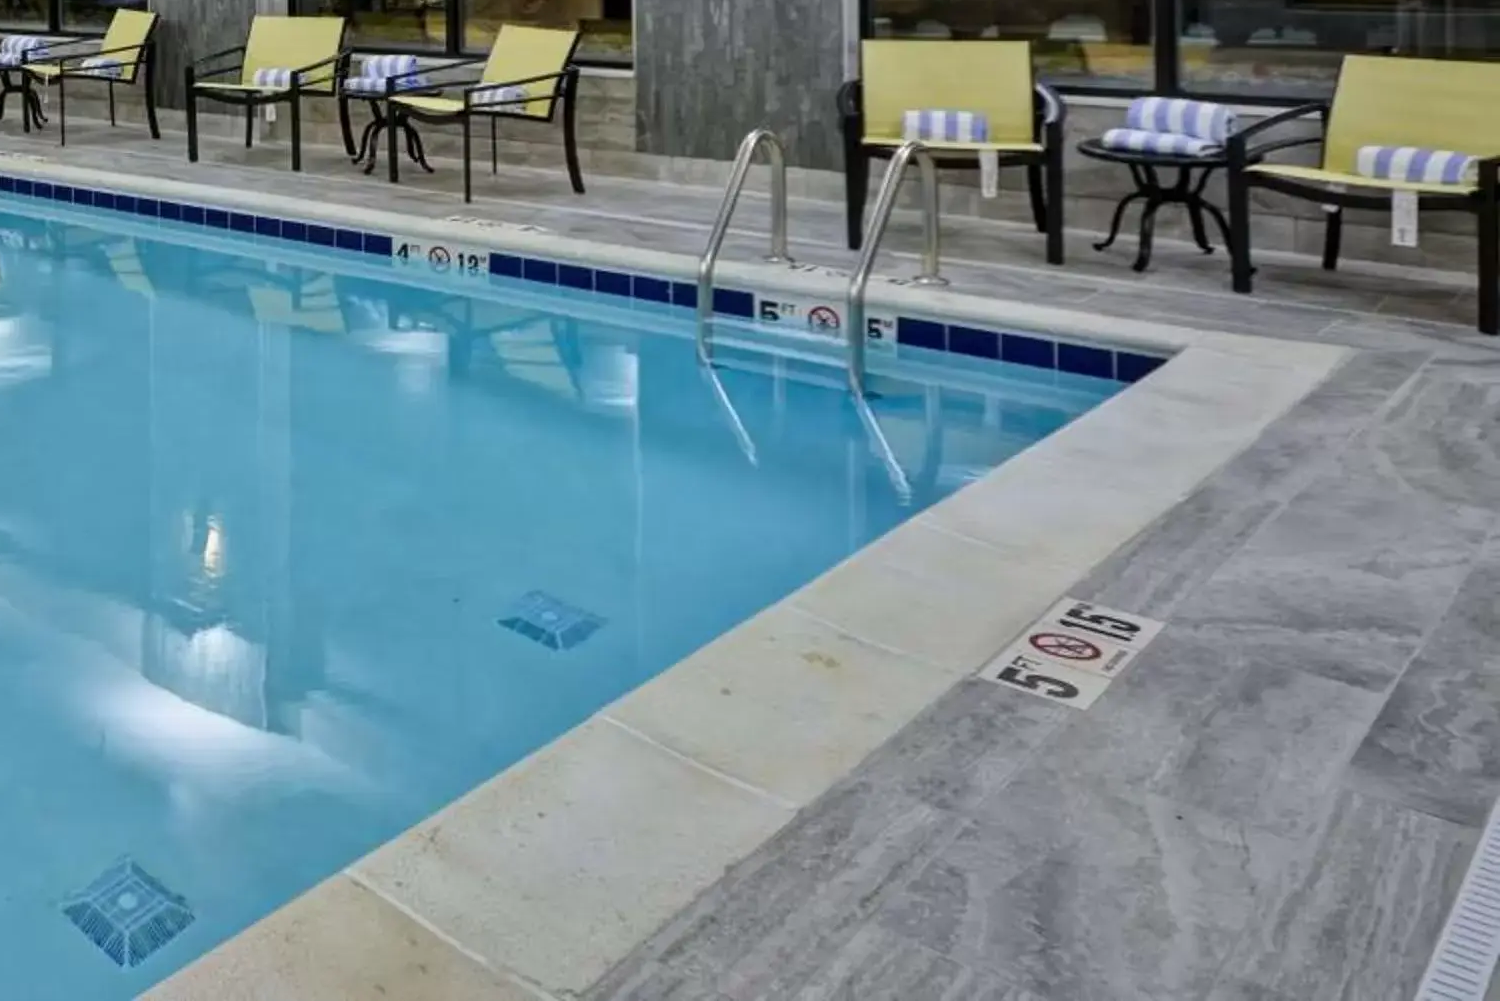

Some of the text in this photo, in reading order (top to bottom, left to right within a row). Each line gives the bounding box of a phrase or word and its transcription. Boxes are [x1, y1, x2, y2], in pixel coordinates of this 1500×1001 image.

[397, 243, 409, 259] 4
[759, 300, 780, 322] 5
[780, 302, 797, 316] FT
[995, 655, 1080, 699] 5 FT
